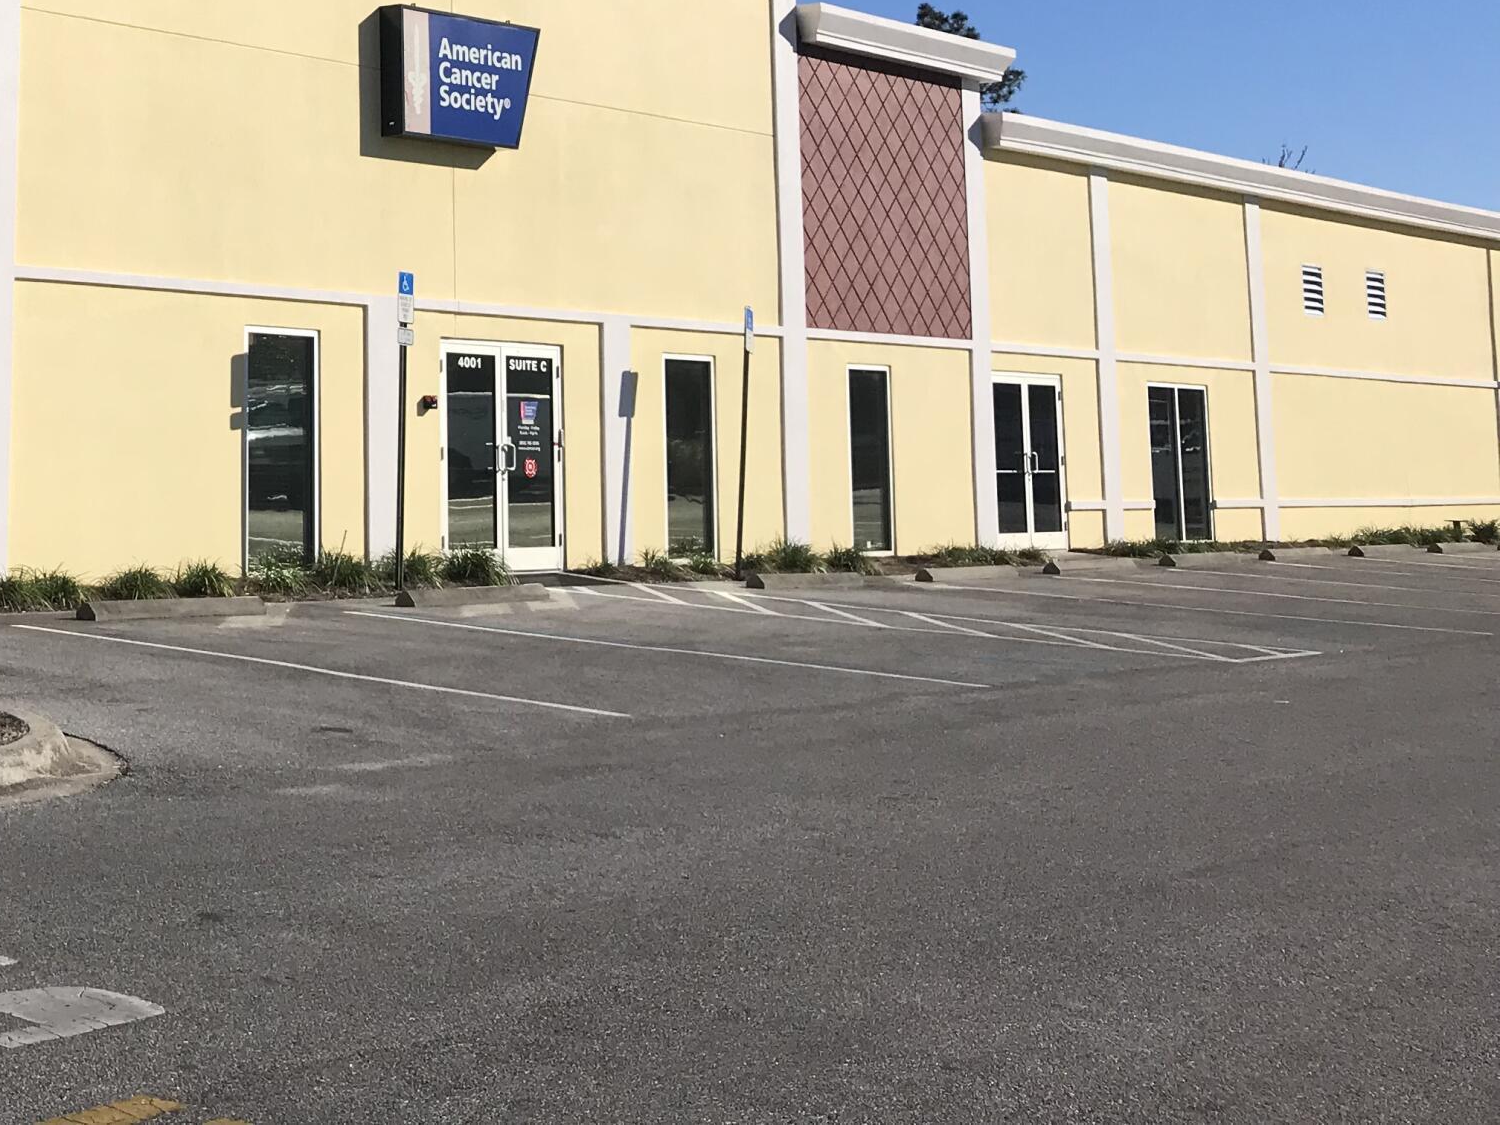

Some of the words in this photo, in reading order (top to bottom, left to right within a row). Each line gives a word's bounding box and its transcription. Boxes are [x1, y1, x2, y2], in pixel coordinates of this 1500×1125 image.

[438, 37, 522, 71] American
[438, 61, 499, 91] Cancer
[457, 356, 482, 369] 4001
[508, 358, 538, 372] SUITE
[540, 360, 547, 373] C
